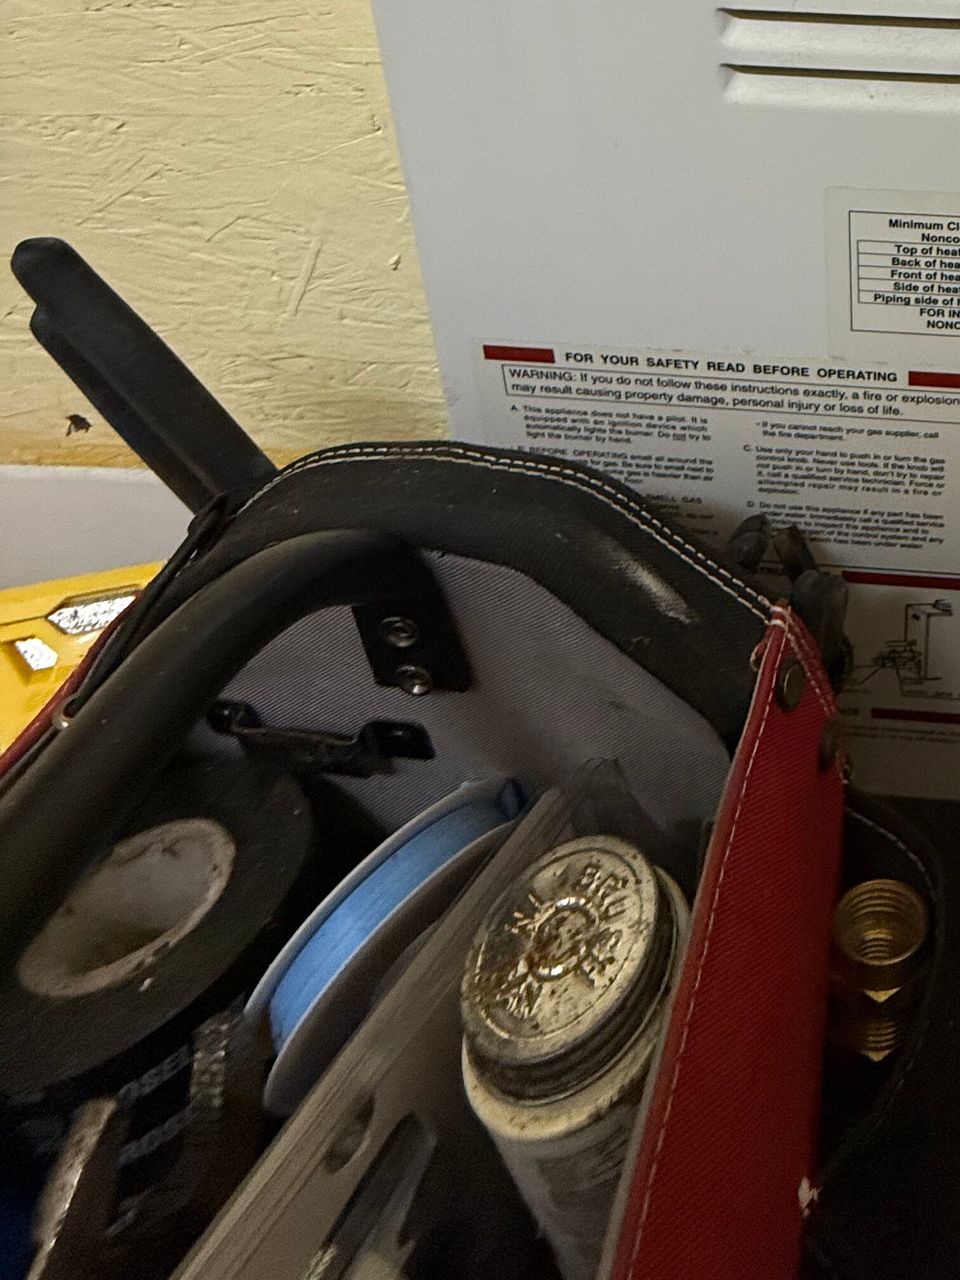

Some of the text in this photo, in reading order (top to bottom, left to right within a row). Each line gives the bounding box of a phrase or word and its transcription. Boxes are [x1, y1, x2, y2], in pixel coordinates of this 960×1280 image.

[888, 218, 943, 230] Minimum
[894, 244, 917, 257] Top
[920, 245, 933, 255] of
[891, 256, 920, 267] Back
[924, 258, 936, 268] of
[888, 269, 921, 279] Front
[925, 271, 937, 280] of
[892, 281, 919, 292] Side
[922, 283, 934, 292] of
[871, 293, 913, 306] Piping
[914, 295, 939, 305] side
[941, 297, 954, 305] of
[919, 307, 945, 317] FOR
[564, 352, 897, 382] FOR YOUR SAFETY READ BEFORE OPERATING
[508, 368, 577, 381] WARNING:
[579, 372, 588, 381] If
[590, 375, 613, 385] you
[615, 375, 631, 385] do
[633, 377, 653, 386] not
[655, 377, 691, 388] follow
[693, 380, 727, 391] these
[730, 384, 799, 396] instructions
[802, 388, 848, 400] exactly,
[850, 391, 860, 399] a
[861, 390, 882, 401] fire
[884, 393, 899, 402] or
